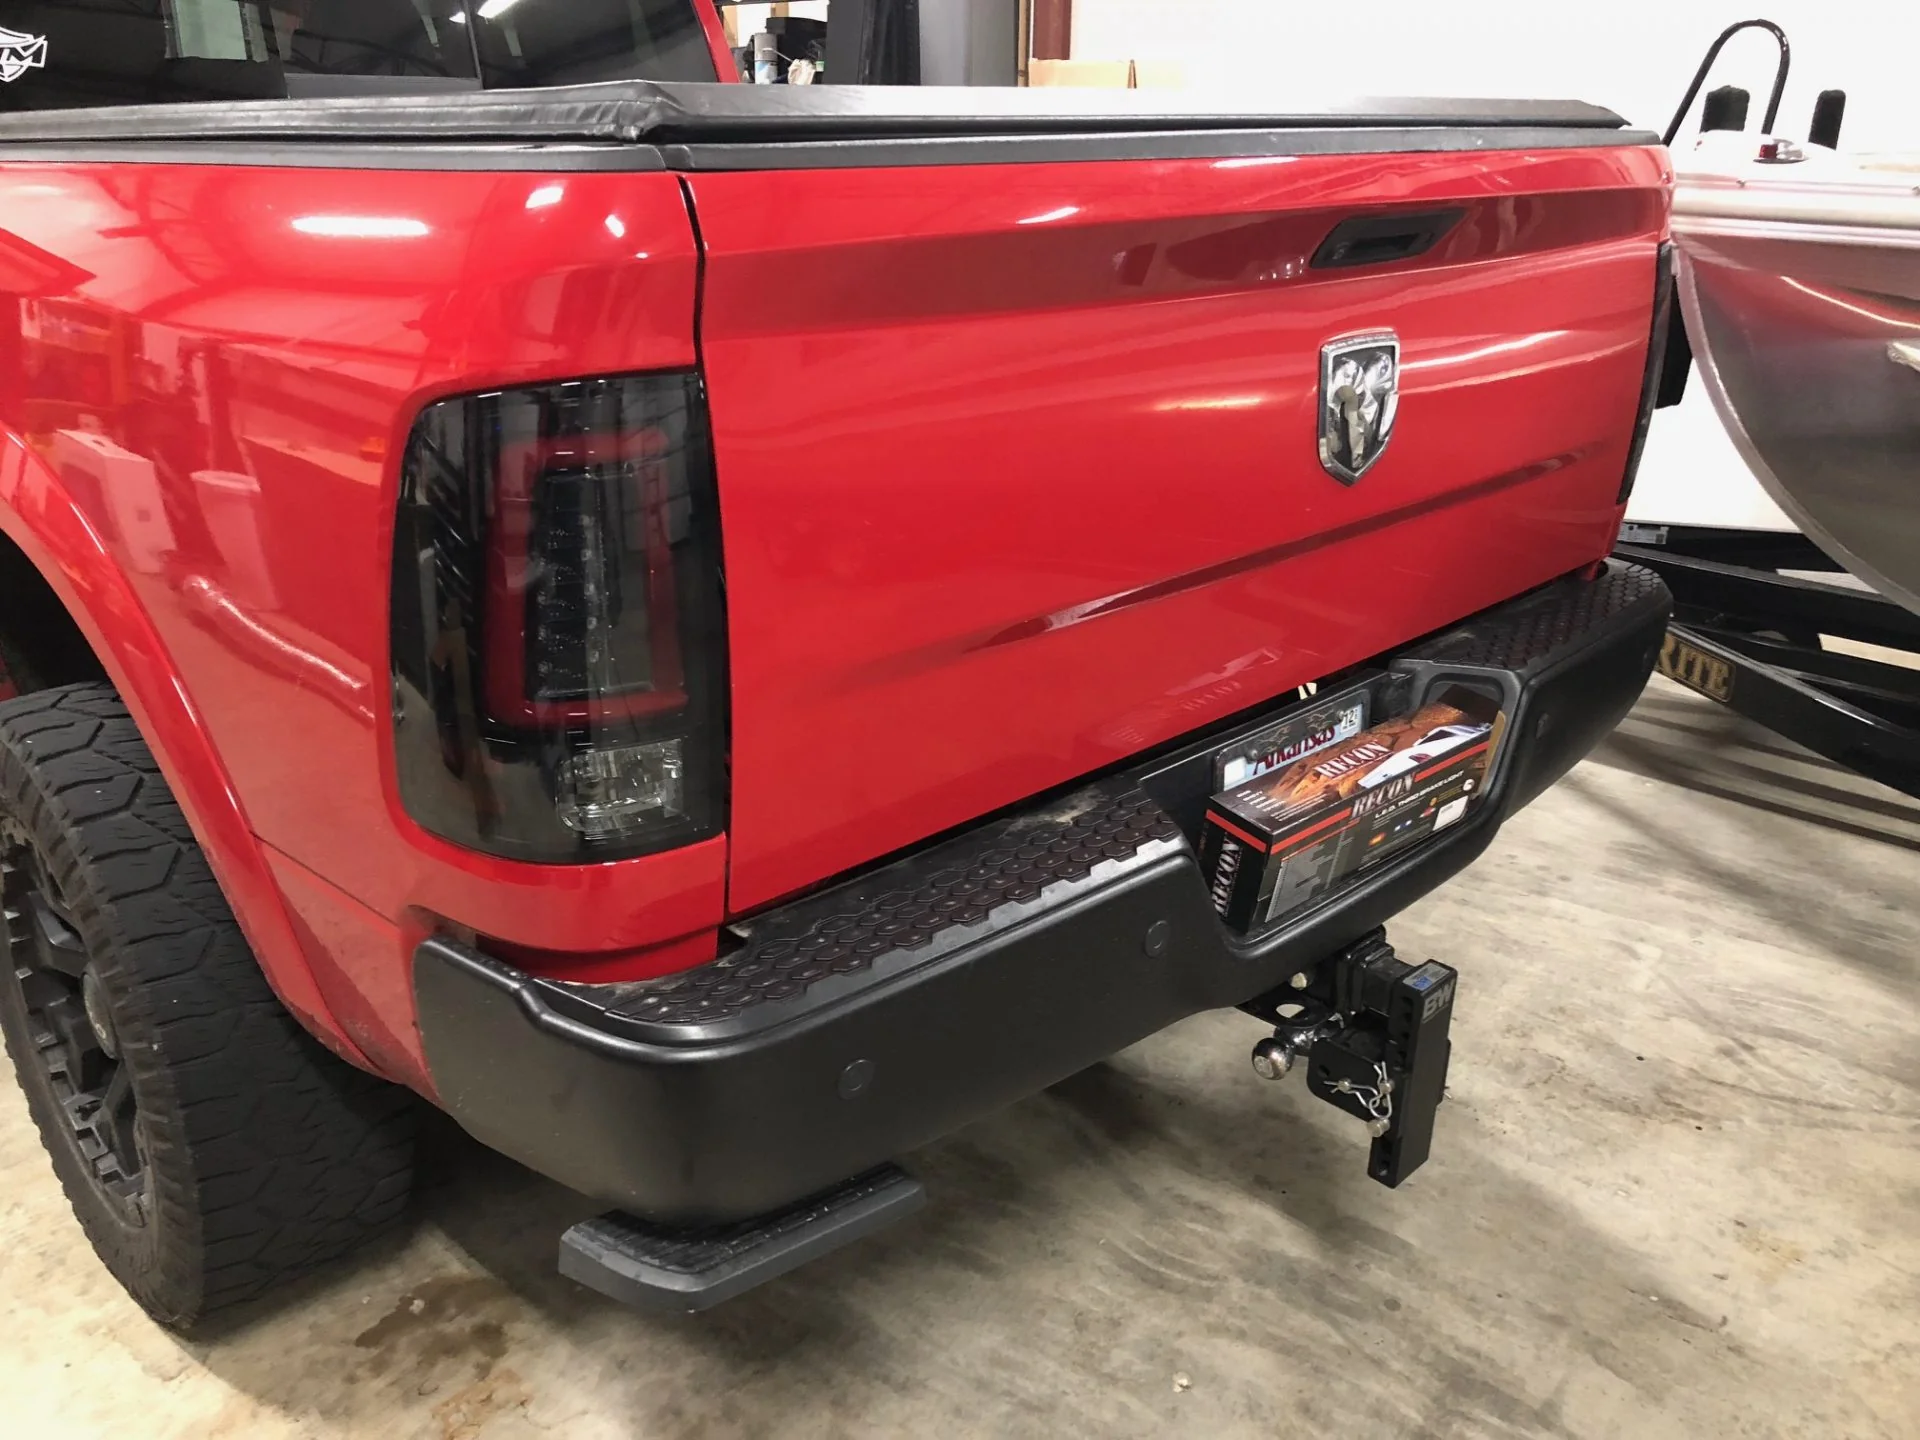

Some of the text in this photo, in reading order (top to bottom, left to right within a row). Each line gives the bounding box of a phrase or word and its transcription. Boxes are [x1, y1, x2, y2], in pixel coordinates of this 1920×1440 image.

[1314, 741, 1391, 778] RECON
[1352, 772, 1416, 818] RECON
[1211, 836, 1240, 915] RECON
